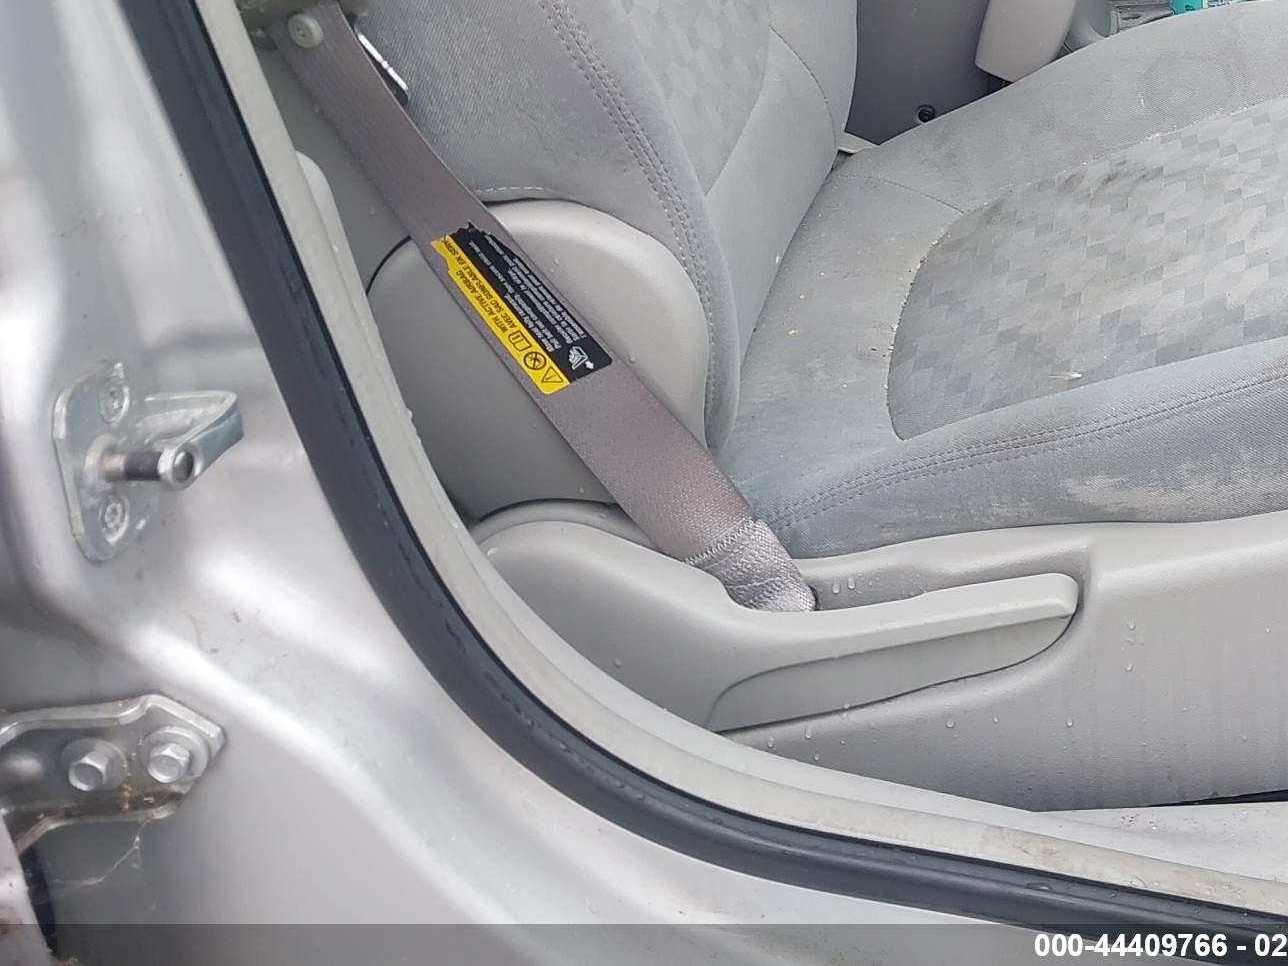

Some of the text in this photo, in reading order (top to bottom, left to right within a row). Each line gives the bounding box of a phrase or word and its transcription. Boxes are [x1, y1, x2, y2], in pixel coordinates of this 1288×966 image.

[462, 264, 493, 300] GONFLABLE
[455, 269, 508, 332] WITH ACTIVE AIRBAG
[490, 299, 503, 313] SAC
[500, 312, 516, 329] AVEC
